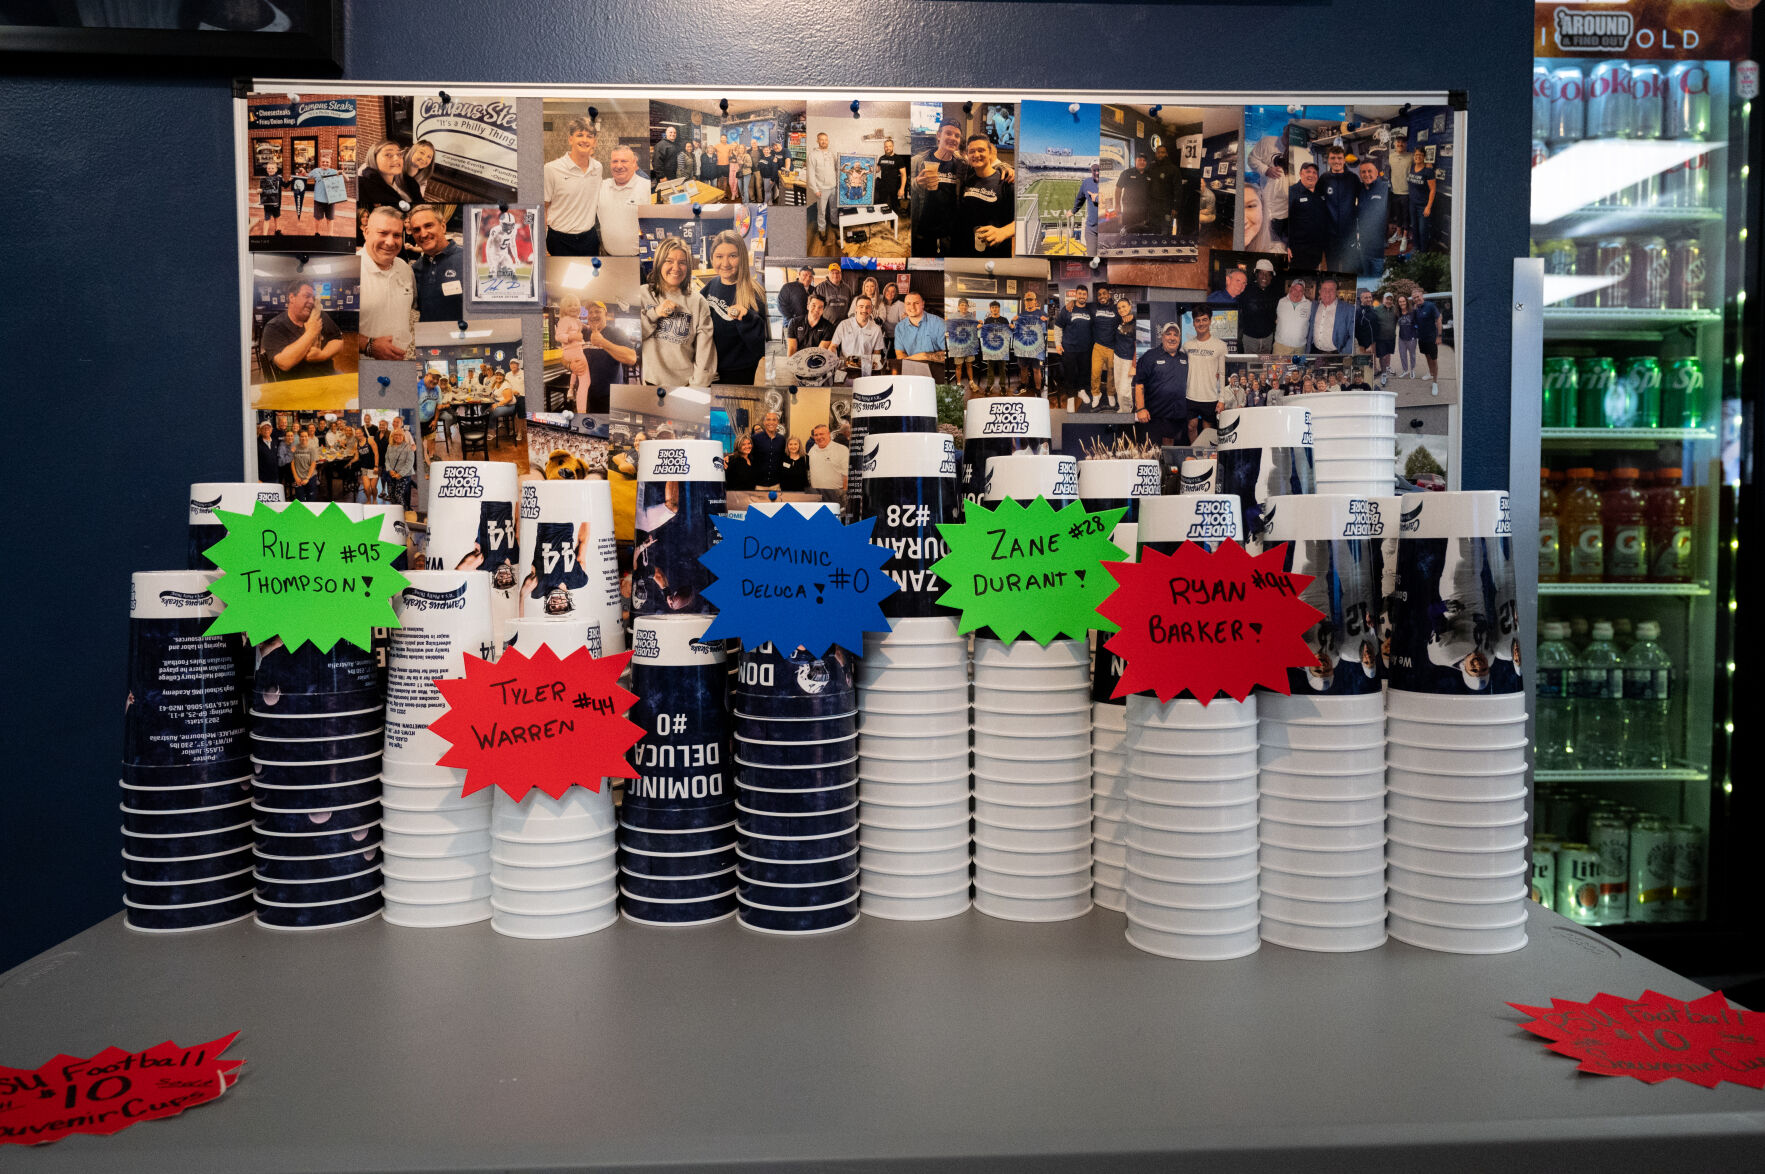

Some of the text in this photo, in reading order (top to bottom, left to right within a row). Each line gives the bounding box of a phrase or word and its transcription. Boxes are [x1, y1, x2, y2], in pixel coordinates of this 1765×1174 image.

[1560, 14, 1629, 35] AROUND
[1636, 29, 1699, 48] OLD
[299, 102, 328, 114] Campus
[328, 101, 354, 111] Steaks
[420, 98, 485, 120] Campus
[461, 123, 485, 137] Philly
[1185, 145, 1197, 158] 31
[683, 228, 693, 238] 26
[500, 238, 511, 250] 5
[862, 398, 892, 412] Campus
[990, 402, 1024, 415] STORE
[994, 412, 1027, 424] BOOK
[983, 422, 1030, 434] STUDENT
[658, 448, 685, 458] STORE
[661, 455, 687, 465] BOOK
[444, 466, 478, 479] STORE
[652, 463, 690, 475] STUDENT
[448, 478, 480, 489] BOOK
[257, 492, 282, 502] STORE
[438, 487, 484, 499] STUDENT
[1195, 501, 1231, 515] STORE
[886, 504, 929, 528] #28
[1201, 513, 1234, 526] BOOK
[486, 520, 515, 552] 44
[987, 516, 1106, 561] ZANE #28
[1187, 525, 1237, 539] STUDENT
[262, 529, 386, 564] RILEY #95
[743, 536, 833, 567] DOMINIC
[541, 541, 576, 574] 44
[828, 567, 870, 594] #0
[1169, 569, 1298, 605] RYAN #94
[160, 597, 214, 608] Campus Steaks
[430, 598, 466, 610] Campus
[636, 629, 656, 641] STORE
[203, 641, 227, 649] Majoring
[637, 639, 657, 649] BOOK
[632, 646, 660, 658] STUDEN
[1398, 656, 1413, 668] We
[158, 667, 179, 675] played
[158, 672, 215, 682] Haileybury College
[204, 687, 223, 695] School
[490, 678, 616, 716] TYLER #44
[209, 708, 233, 716] Punting:
[655, 713, 688, 737] #0
[179, 732, 216, 741] Melbourne,
[471, 719, 575, 751] WARREN
[204, 746, 224, 754] CLASS:
[633, 743, 720, 768] DELUCA
[193, 754, 216, 762] Punter
[627, 774, 723, 800] DOMINIC
[1623, 1002, 1746, 1027] Football
[0, 1049, 210, 1097] SU Football
[0, 1109, 120, 1138] ouvenir
